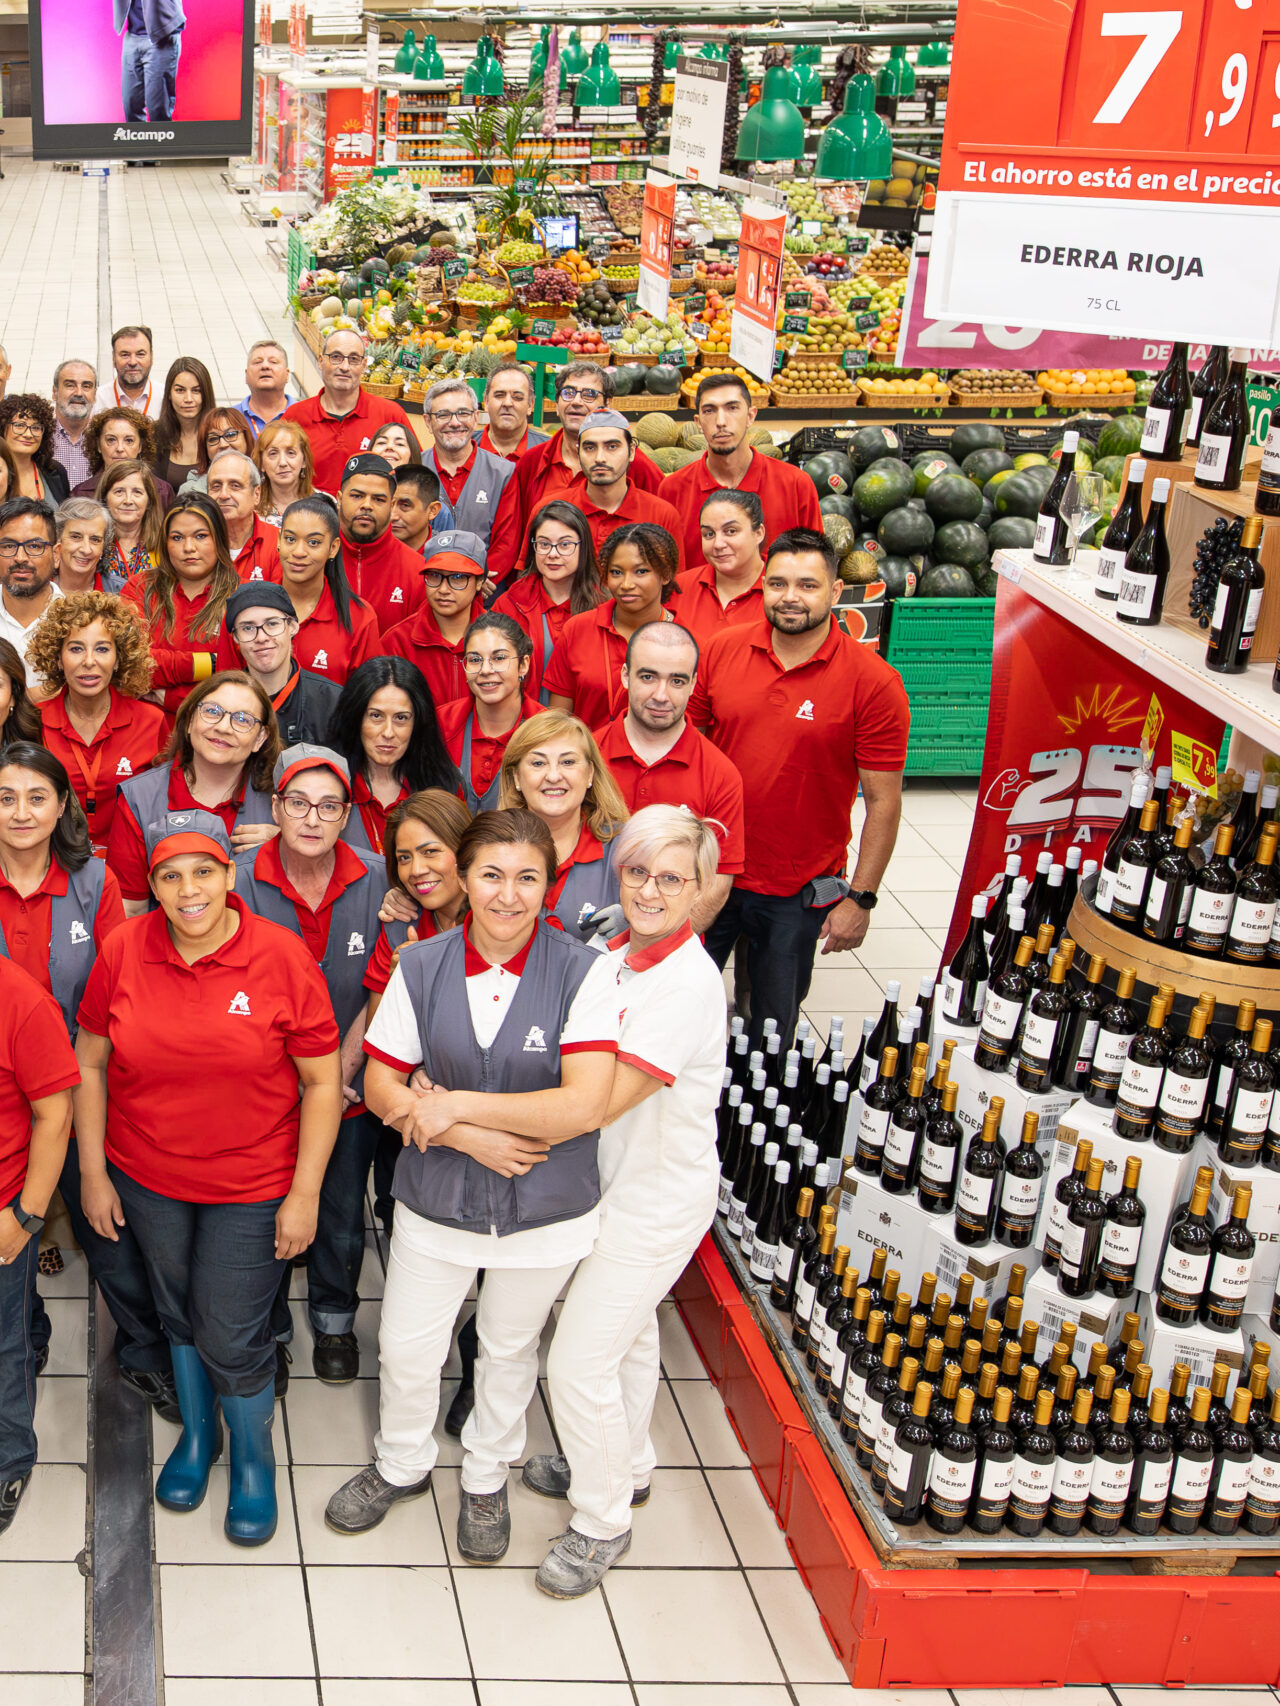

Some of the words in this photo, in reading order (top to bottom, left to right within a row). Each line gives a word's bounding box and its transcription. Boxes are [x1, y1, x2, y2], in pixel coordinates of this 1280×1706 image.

[113, 127, 175, 143] Alcampo
[964, 161, 987, 182] El
[991, 163, 1074, 186] ahorro
[1078, 164, 1132, 189] está
[1136, 173, 1170, 190] en
[1174, 168, 1198, 191] el
[1020, 244, 1119, 270] EDERRA
[1127, 252, 1205, 281] RIOJA
[1086, 297, 1102, 310] 75
[1106, 299, 1121, 312] CL
[1142, 344, 1171, 361] DE
[1249, 389, 1272, 402] pasillo
[1006, 745, 1154, 828] 25
[1167, 1093, 1198, 1106] EDERRA
[858, 1229, 903, 1260] EDERRA
[1167, 1267, 1198, 1282] EDERRA
[936, 1474, 967, 1488] EDERRA
[1017, 1478, 1049, 1490] EDERRA
